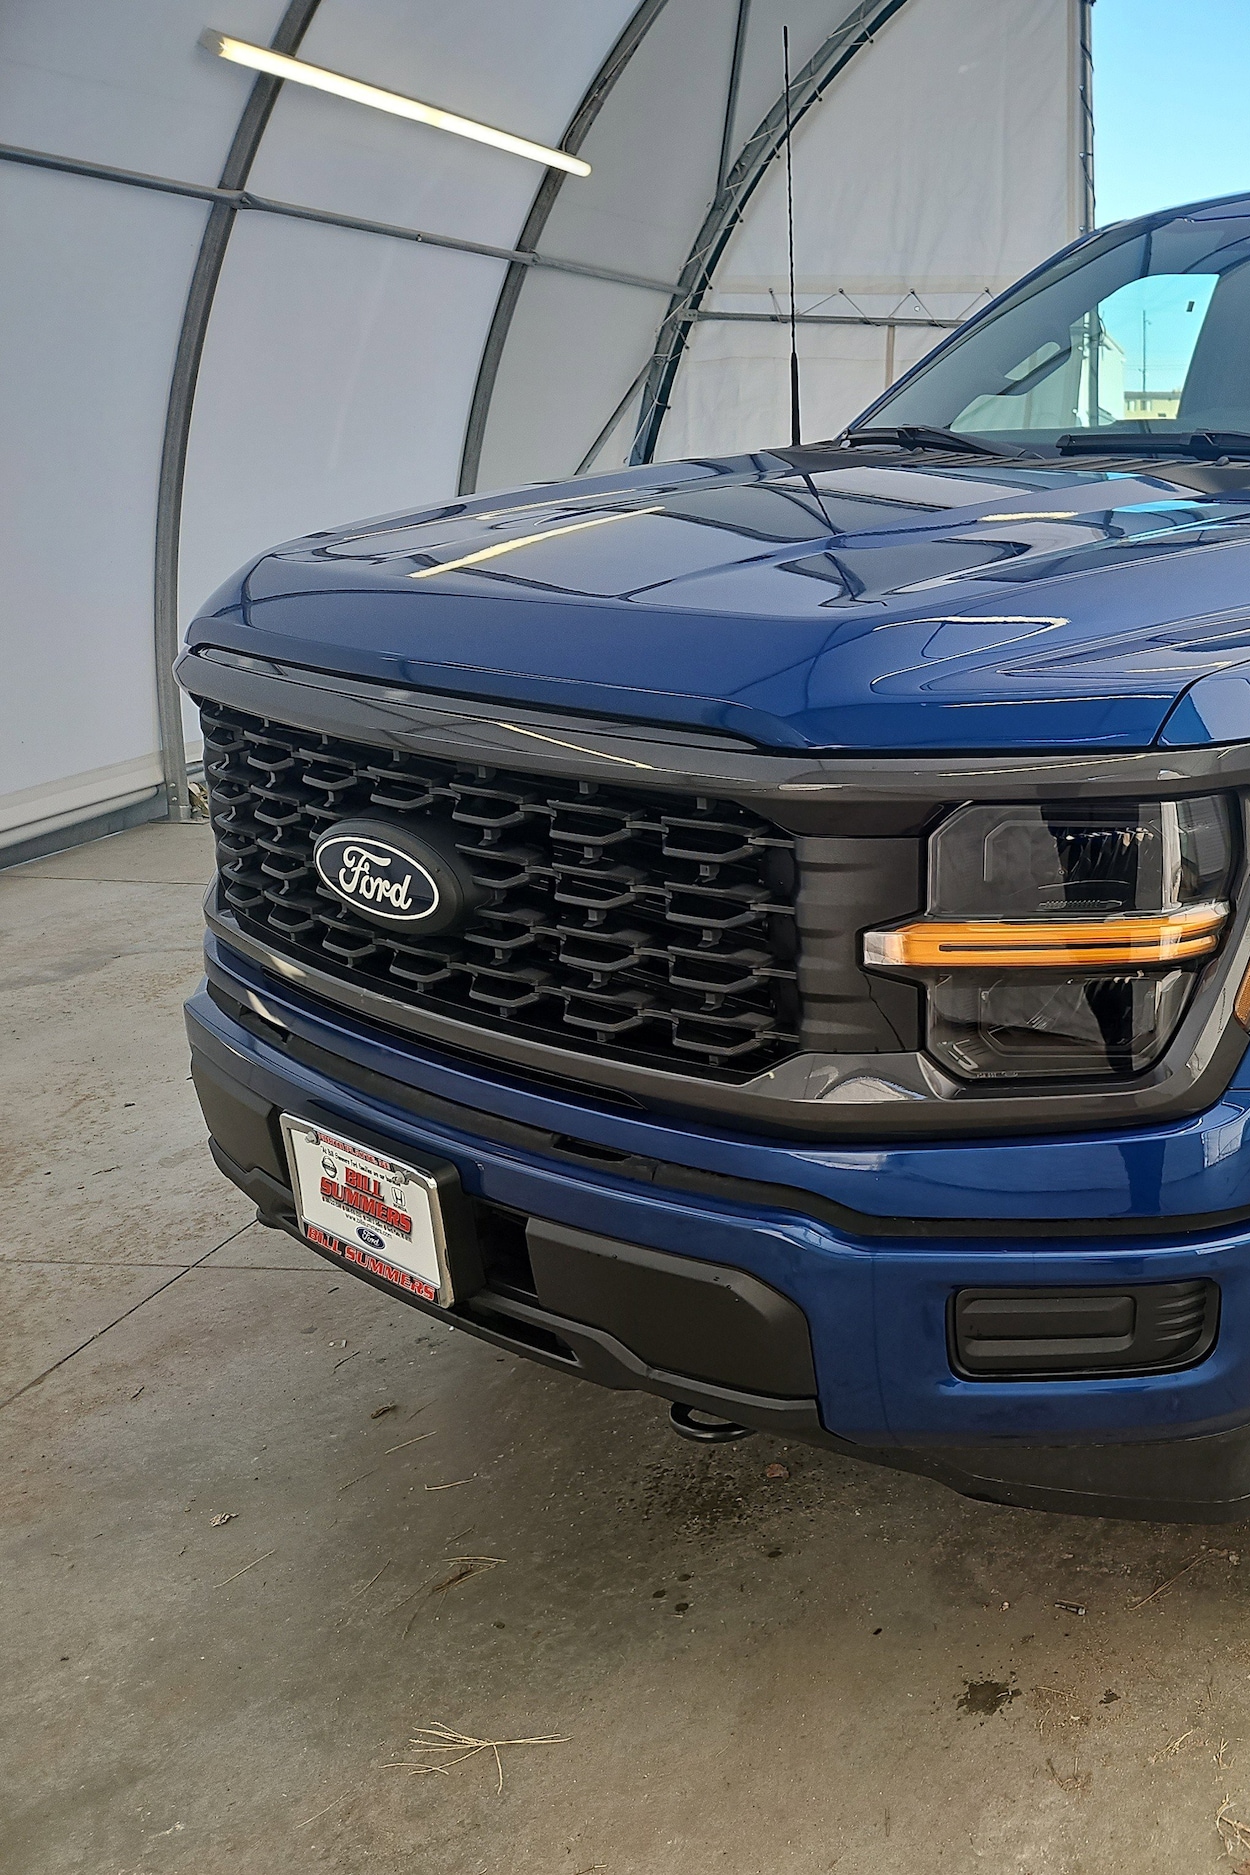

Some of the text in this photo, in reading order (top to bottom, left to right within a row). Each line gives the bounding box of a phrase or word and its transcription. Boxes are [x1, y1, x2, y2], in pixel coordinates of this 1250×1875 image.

[338, 845, 413, 910] Ford
[320, 1176, 413, 1235] SUMMERS
[344, 1166, 385, 1201] BILL
[306, 1226, 342, 1256] BILL
[344, 1246, 435, 1302] SUMMERS
